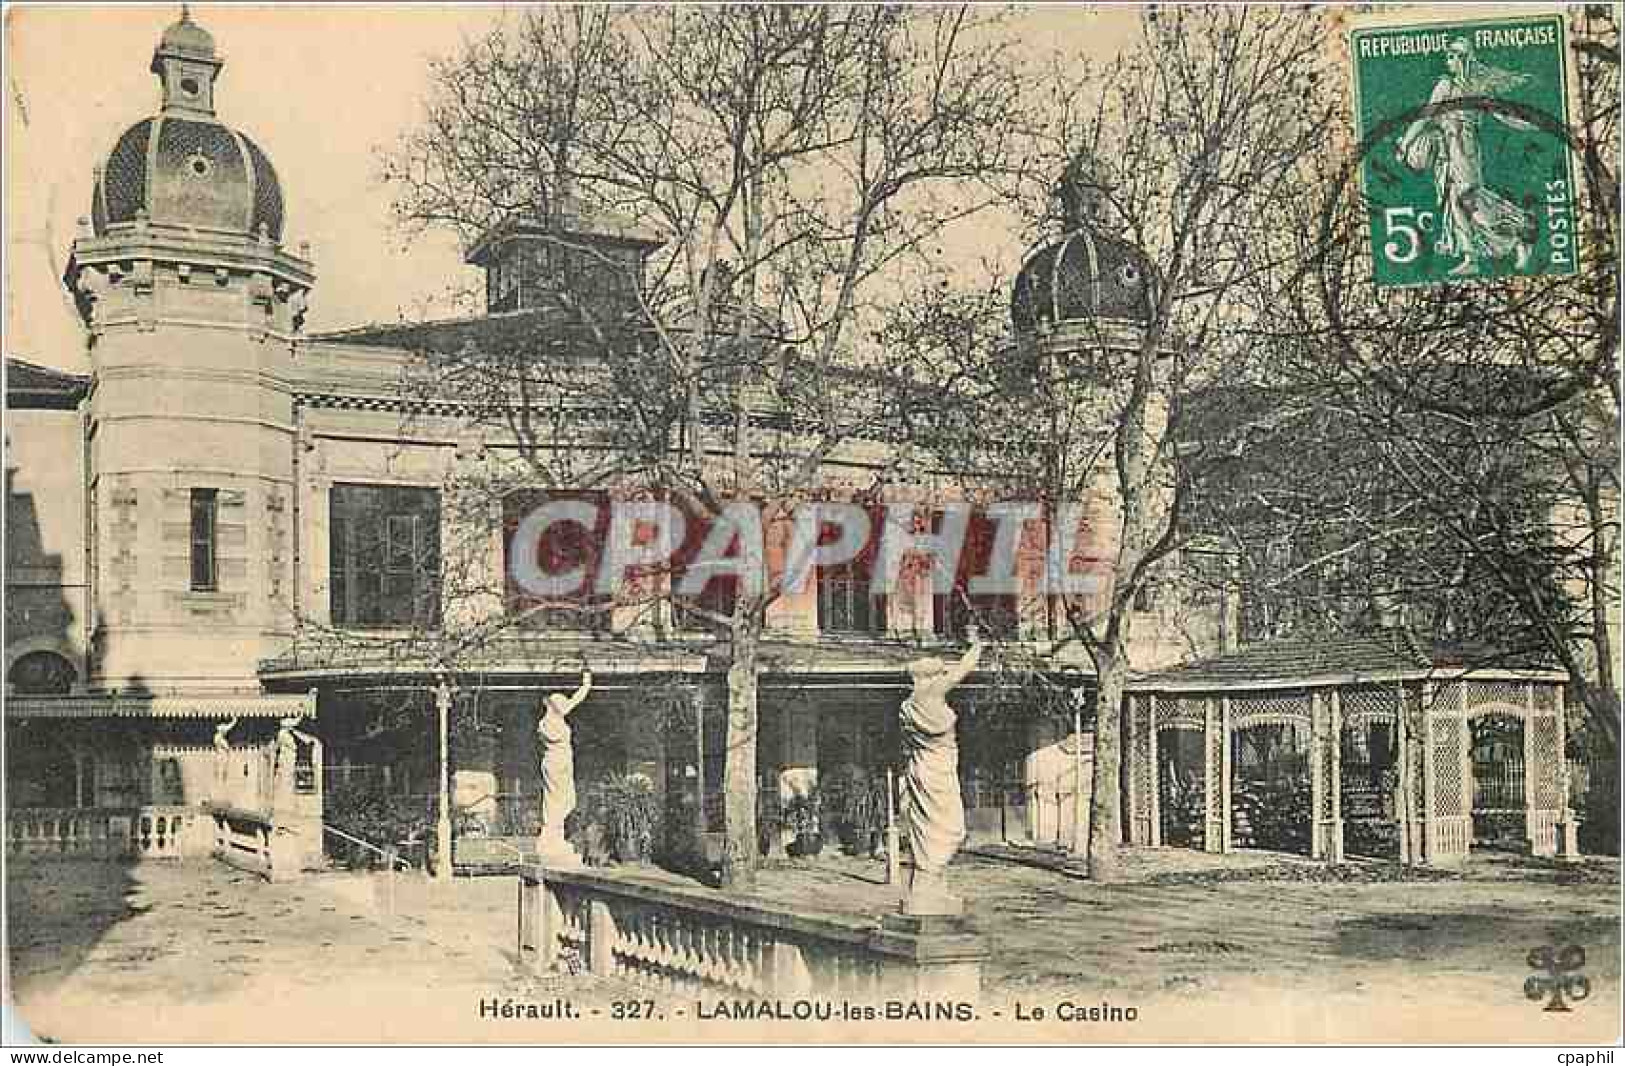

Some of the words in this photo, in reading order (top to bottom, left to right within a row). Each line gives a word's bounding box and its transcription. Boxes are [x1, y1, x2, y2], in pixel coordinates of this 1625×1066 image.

[1359, 33, 1450, 58] REPUBLIQUE
[1474, 26, 1556, 49] FRANÇAISE
[1546, 180, 1571, 264] POSTES
